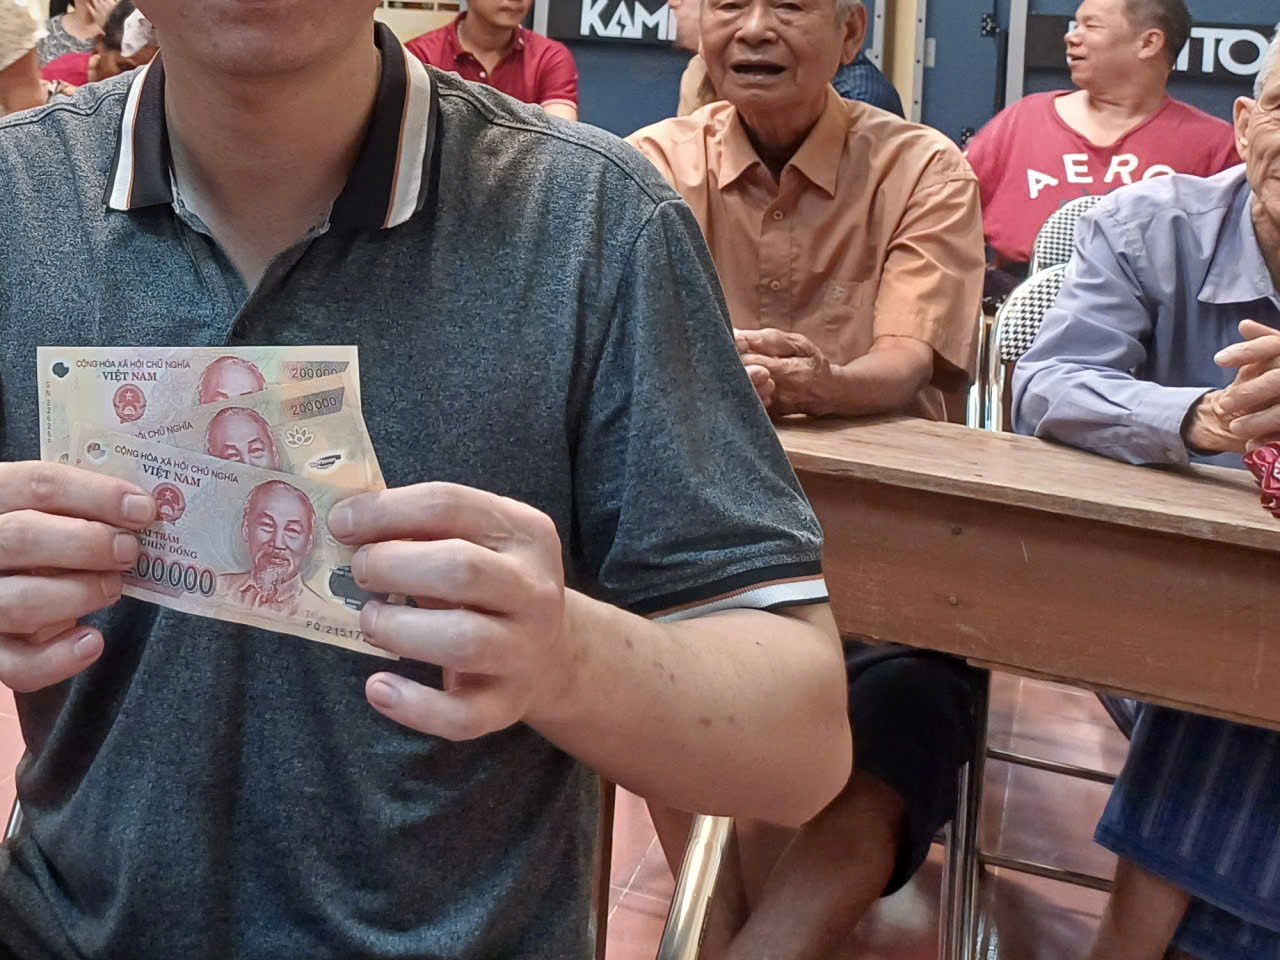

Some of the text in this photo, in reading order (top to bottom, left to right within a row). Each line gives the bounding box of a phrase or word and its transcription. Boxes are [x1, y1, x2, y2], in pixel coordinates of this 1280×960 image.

[102, 369, 157, 383] VIỆT NAM
[142, 464, 202, 487] VIỆT NAM
[190, 465, 210, 476] CHỦ
[211, 470, 239, 483] NGHĨA
[138, 537, 166, 550] GHÌN
[325, 625, 366, 642] 21517
